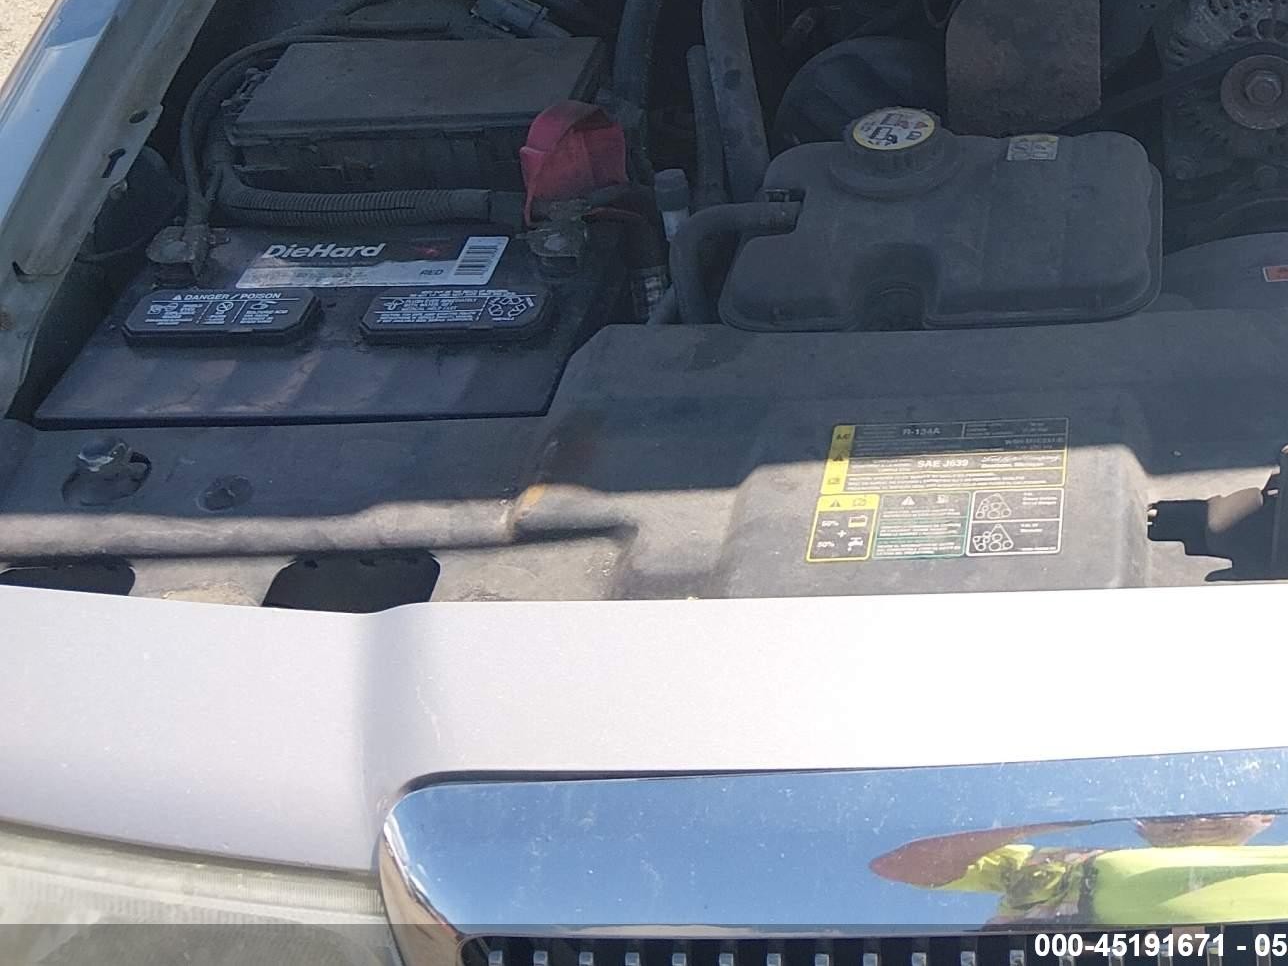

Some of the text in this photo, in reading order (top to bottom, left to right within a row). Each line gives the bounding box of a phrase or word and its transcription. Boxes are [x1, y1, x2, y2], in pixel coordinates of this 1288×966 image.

[261, 243, 386, 259] DieHard
[917, 460, 941, 468] SAE
[942, 459, 969, 468] J639
